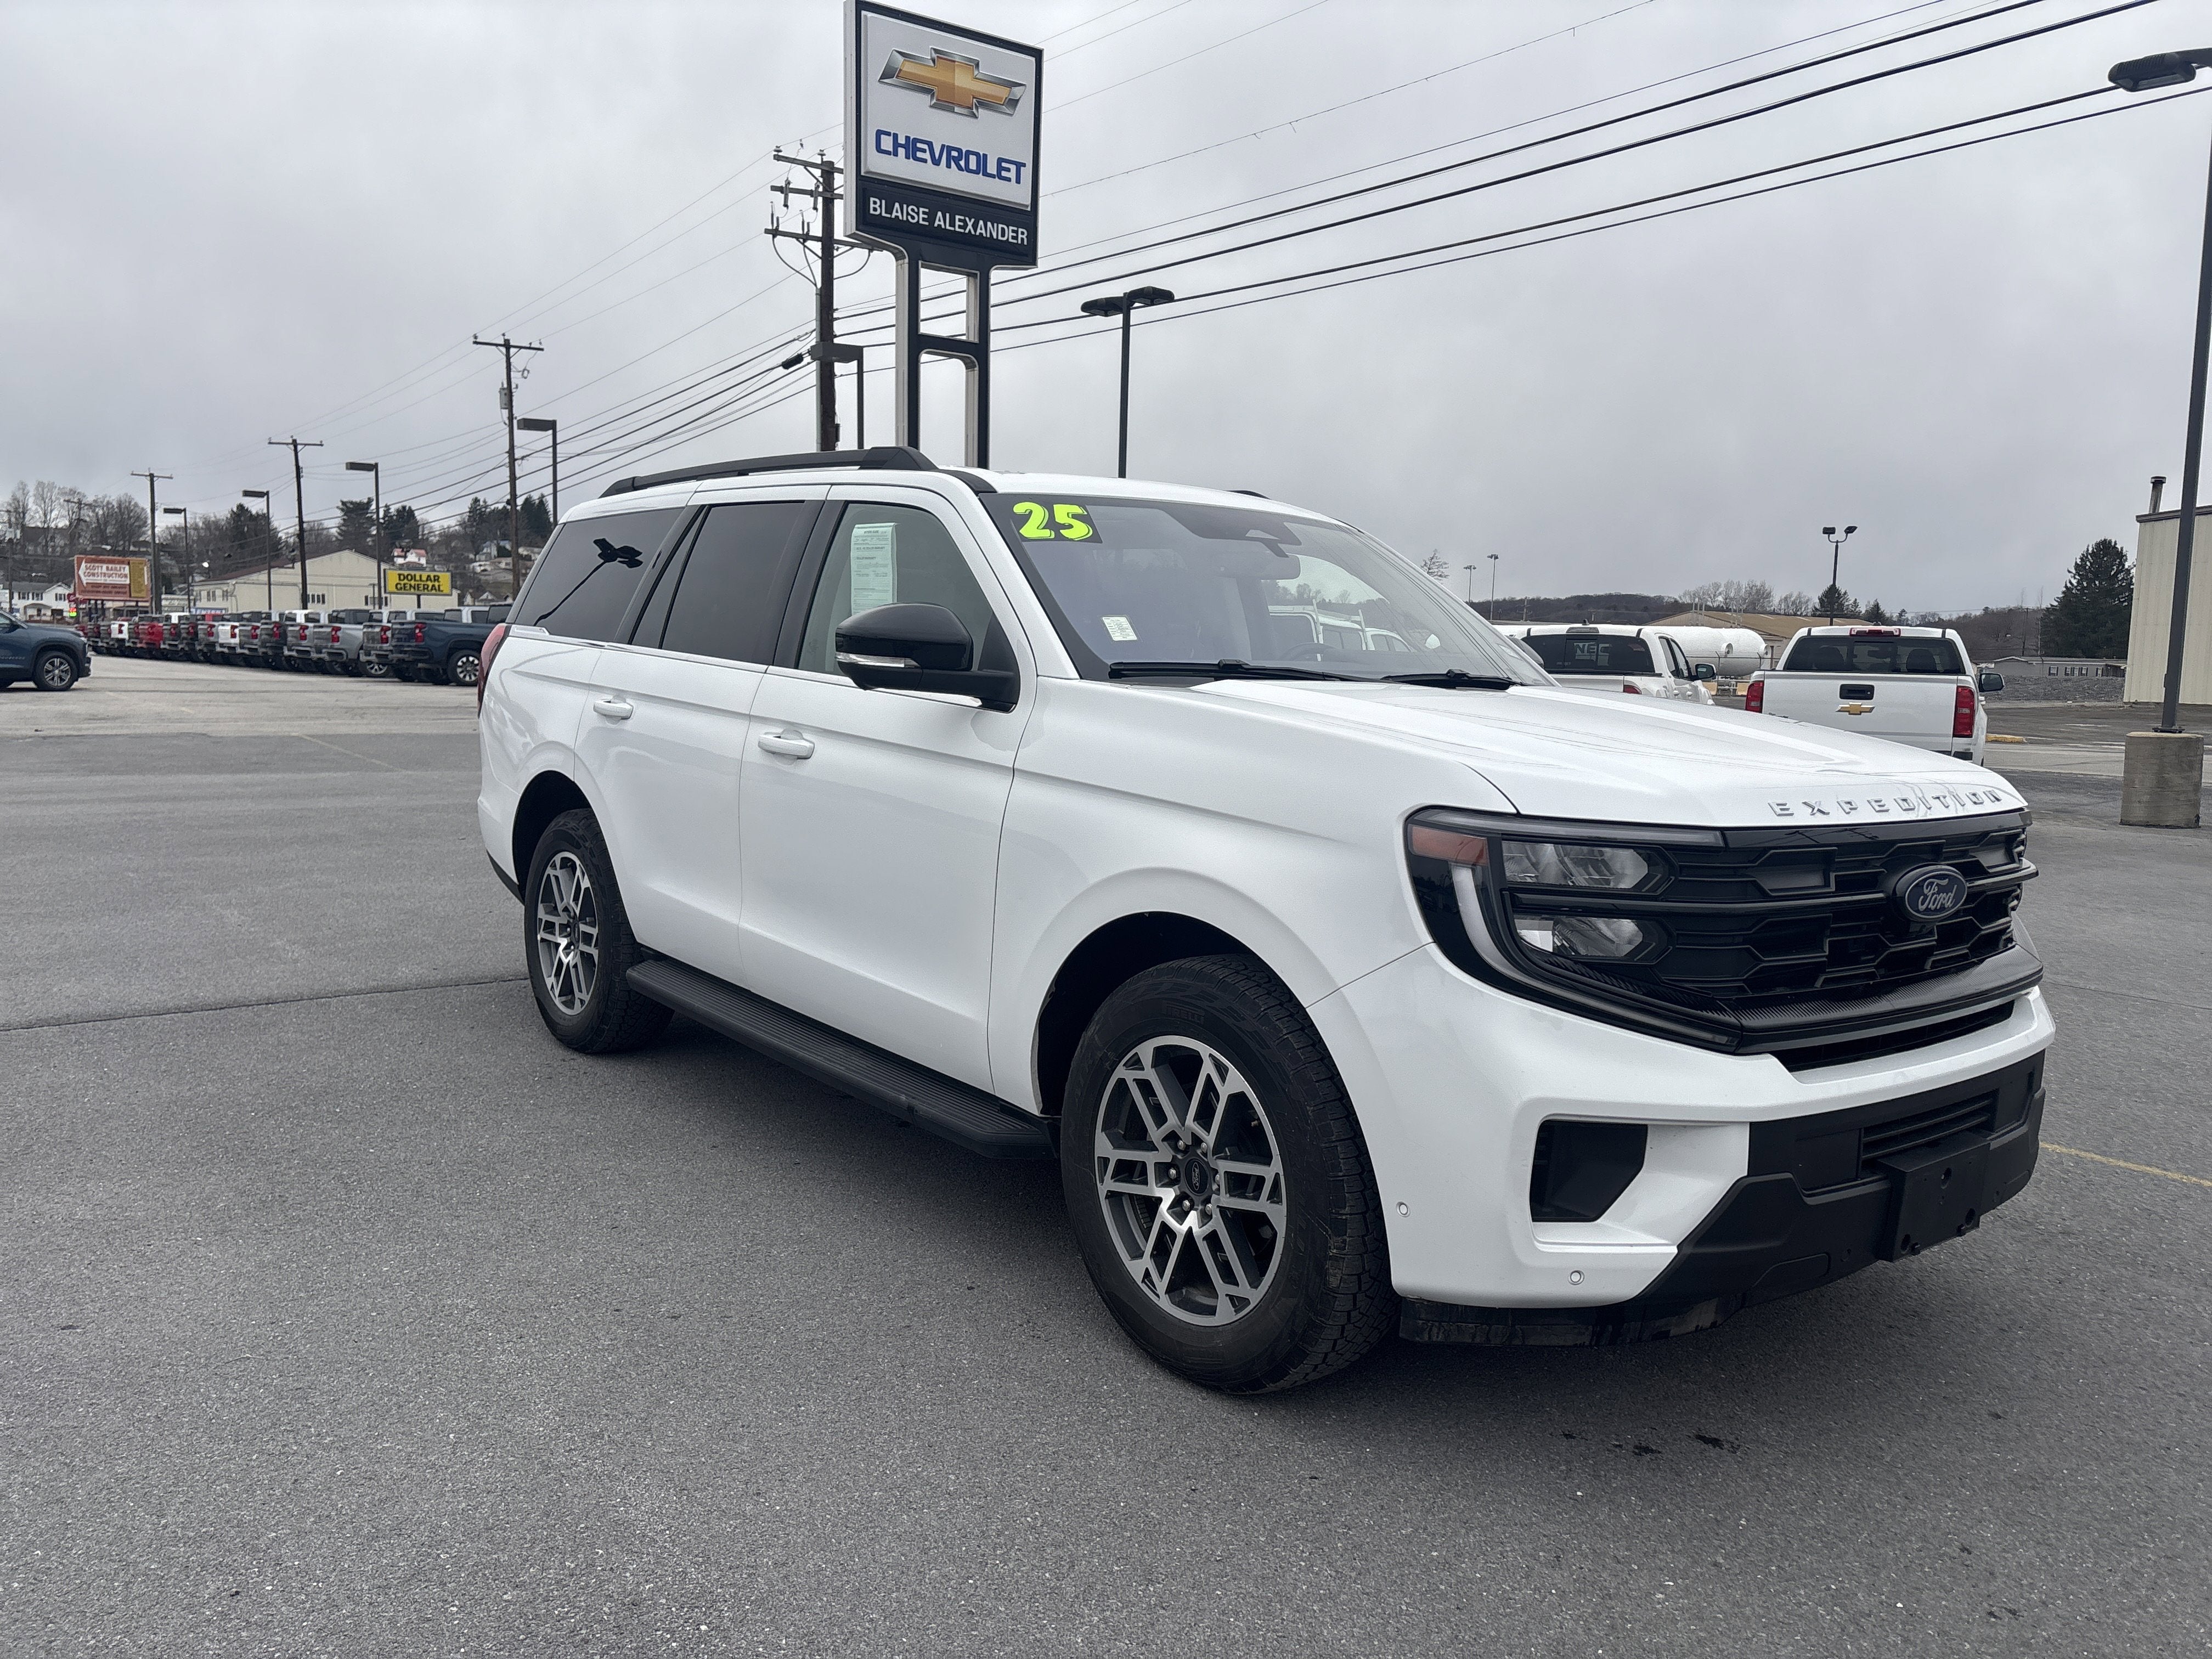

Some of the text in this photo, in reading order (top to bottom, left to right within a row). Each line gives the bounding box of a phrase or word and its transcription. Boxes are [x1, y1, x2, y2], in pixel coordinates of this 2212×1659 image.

[875, 128, 1026, 185] CHEVROLET
[869, 197, 1028, 245] BLAISE ALEXANDER
[1013, 501, 1093, 541] 25
[395, 582, 444, 592] GENERAL
[398, 573, 441, 583] DOLLAR
[1768, 789, 2003, 817] EXPEDITION
[1918, 878, 1957, 912] Ford
